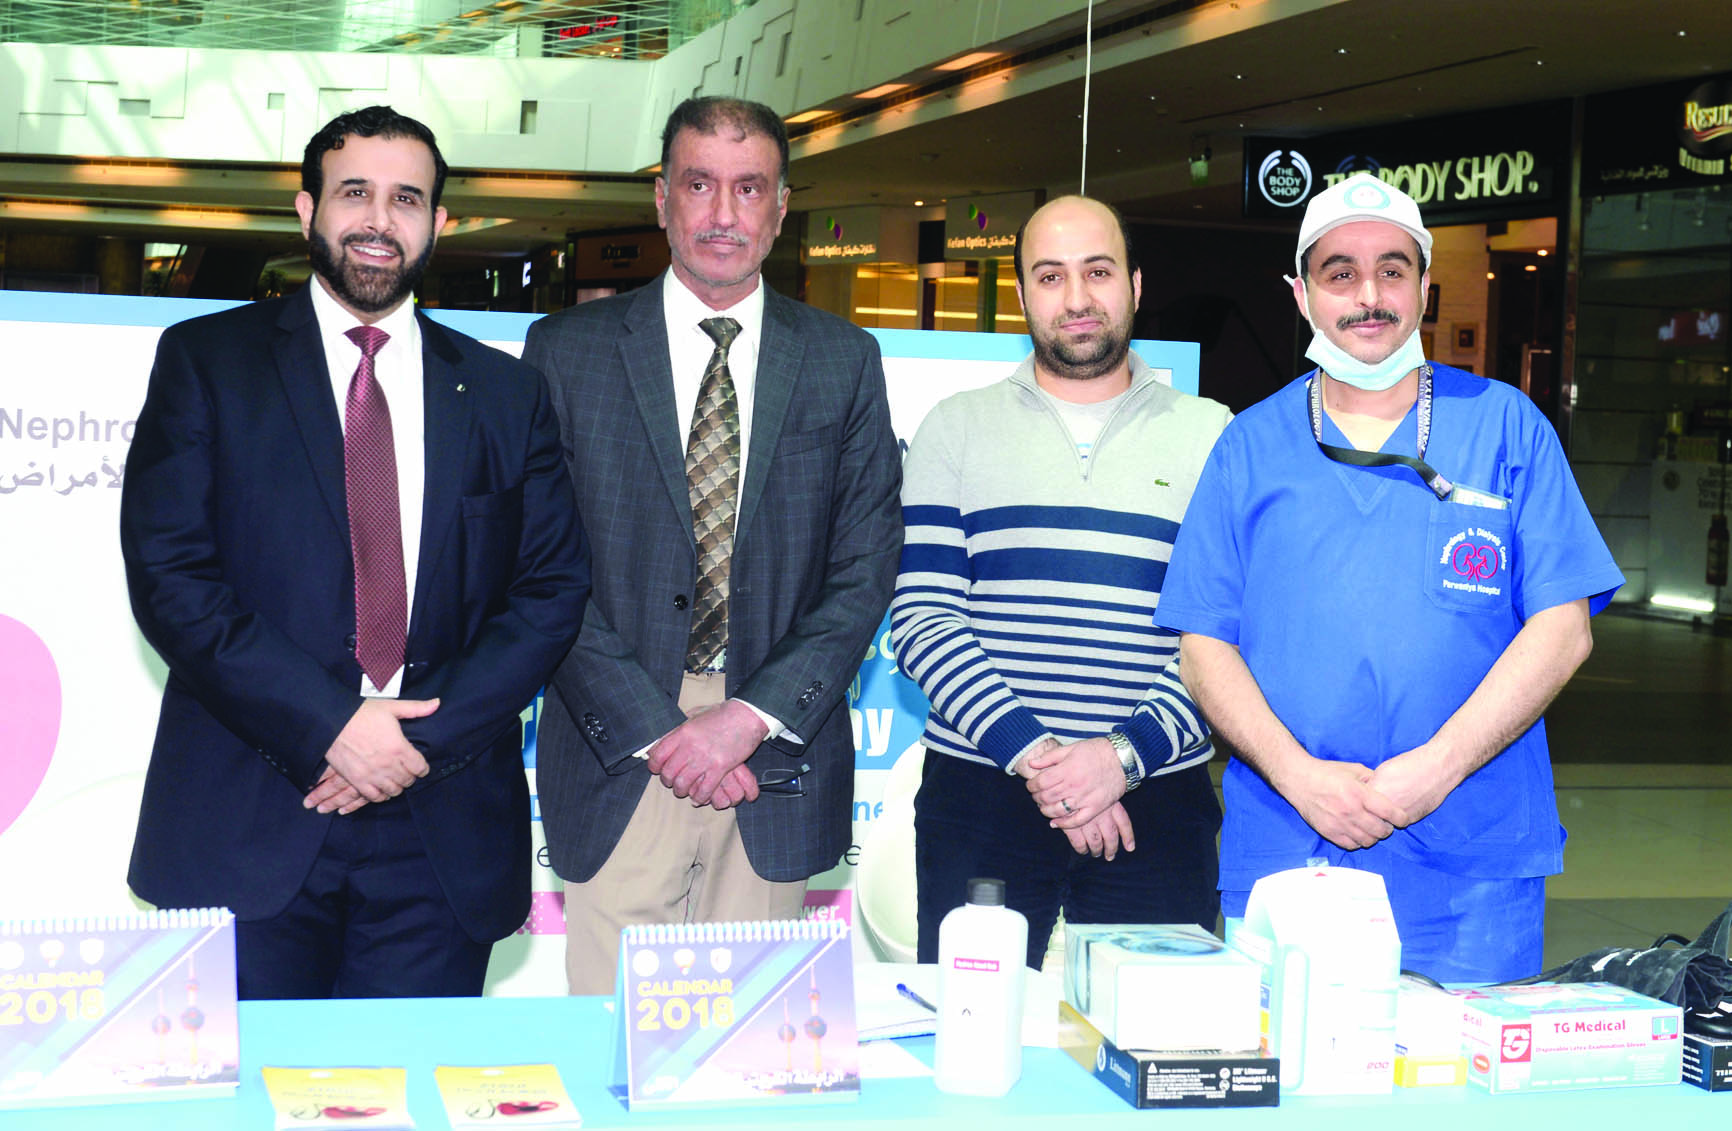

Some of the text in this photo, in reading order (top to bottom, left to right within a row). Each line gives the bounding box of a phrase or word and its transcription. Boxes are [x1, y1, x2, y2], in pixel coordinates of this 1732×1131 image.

[1277, 168, 1294, 176] THE
[1269, 176, 1301, 187] BODY
[1271, 187, 1300, 196] SHOP
[966, 236, 987, 250] Optics
[825, 245, 842, 258] Optics
[1, 970, 104, 990] CALENDAR
[637, 979, 733, 997] CALENDAR
[0, 988, 105, 1025] 2018
[636, 996, 735, 1031] 2018
[1553, 1019, 1626, 1034] TG Medical
[1660, 1019, 1670, 1033] L
